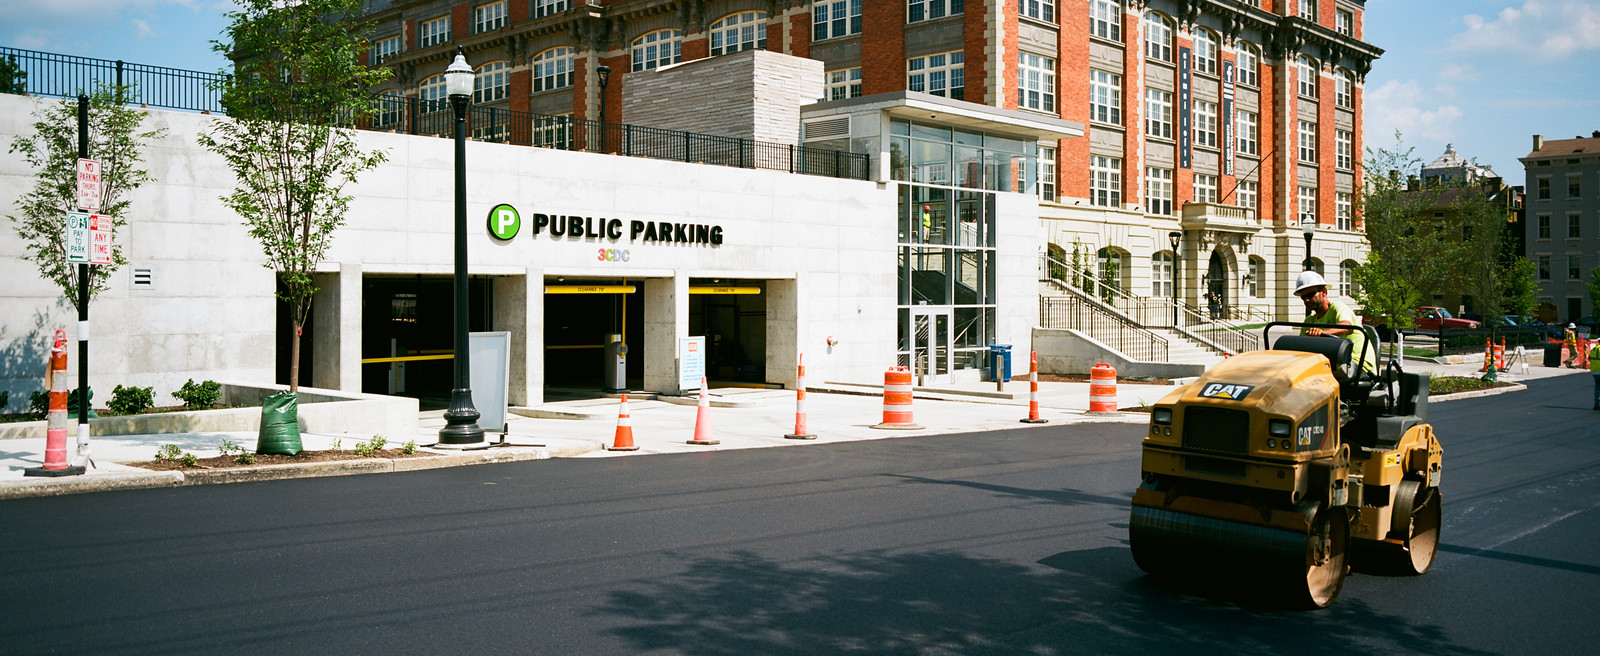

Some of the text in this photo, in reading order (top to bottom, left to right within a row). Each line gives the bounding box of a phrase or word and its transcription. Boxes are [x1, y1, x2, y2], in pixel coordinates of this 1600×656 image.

[85, 163, 94, 172] NO
[80, 172, 99, 183] PARKING
[498, 209, 515, 234] P
[532, 213, 724, 245] PUBLIC PARKING
[94, 233, 107, 242] ANY
[70, 245, 85, 253] PARK
[94, 244, 108, 254] TIME
[597, 248, 631, 262] 3CDC
[1203, 383, 1249, 399] CAT
[1298, 426, 1312, 446] CAT
